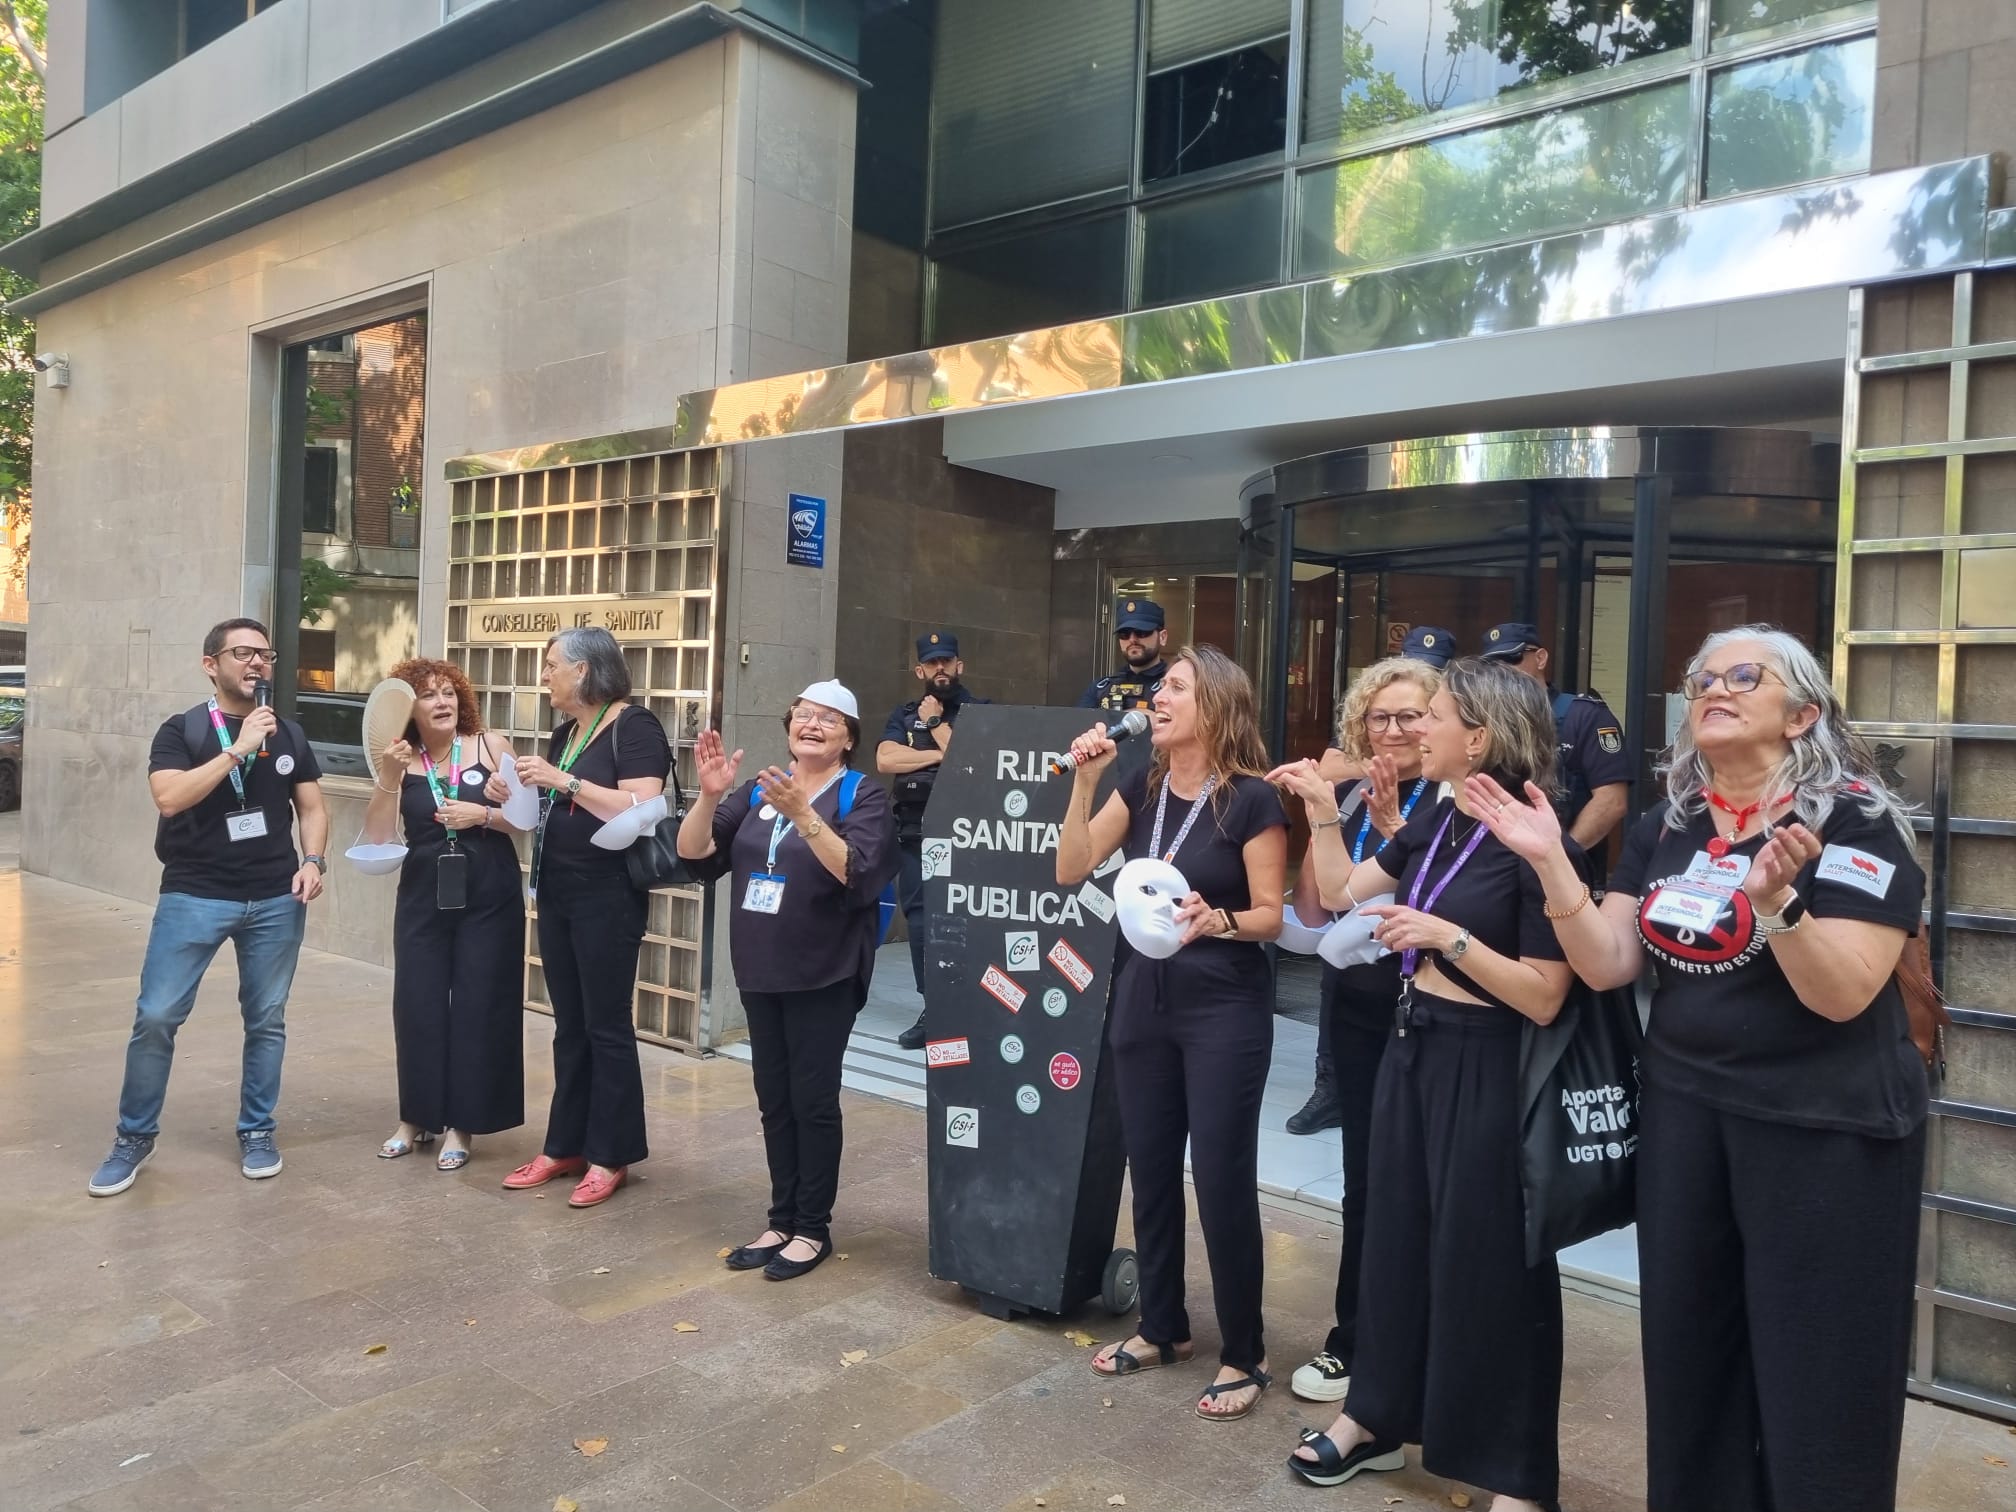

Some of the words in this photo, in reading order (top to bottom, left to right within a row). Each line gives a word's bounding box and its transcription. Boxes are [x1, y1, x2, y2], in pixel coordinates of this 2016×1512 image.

[482, 613, 561, 633] CONSELLERIA
[574, 612, 592, 628] DE
[604, 610, 664, 630] SANITAT
[1826, 863, 1882, 885] INTERSINDICAL
[947, 883, 1084, 926] PUBLICA
[1670, 957, 1711, 974] DRETS
[1714, 963, 1733, 974] NO
[1732, 953, 1751, 967] ES
[1562, 1084, 1625, 1110] Aporta
[1566, 1144, 1604, 1163] UGT
